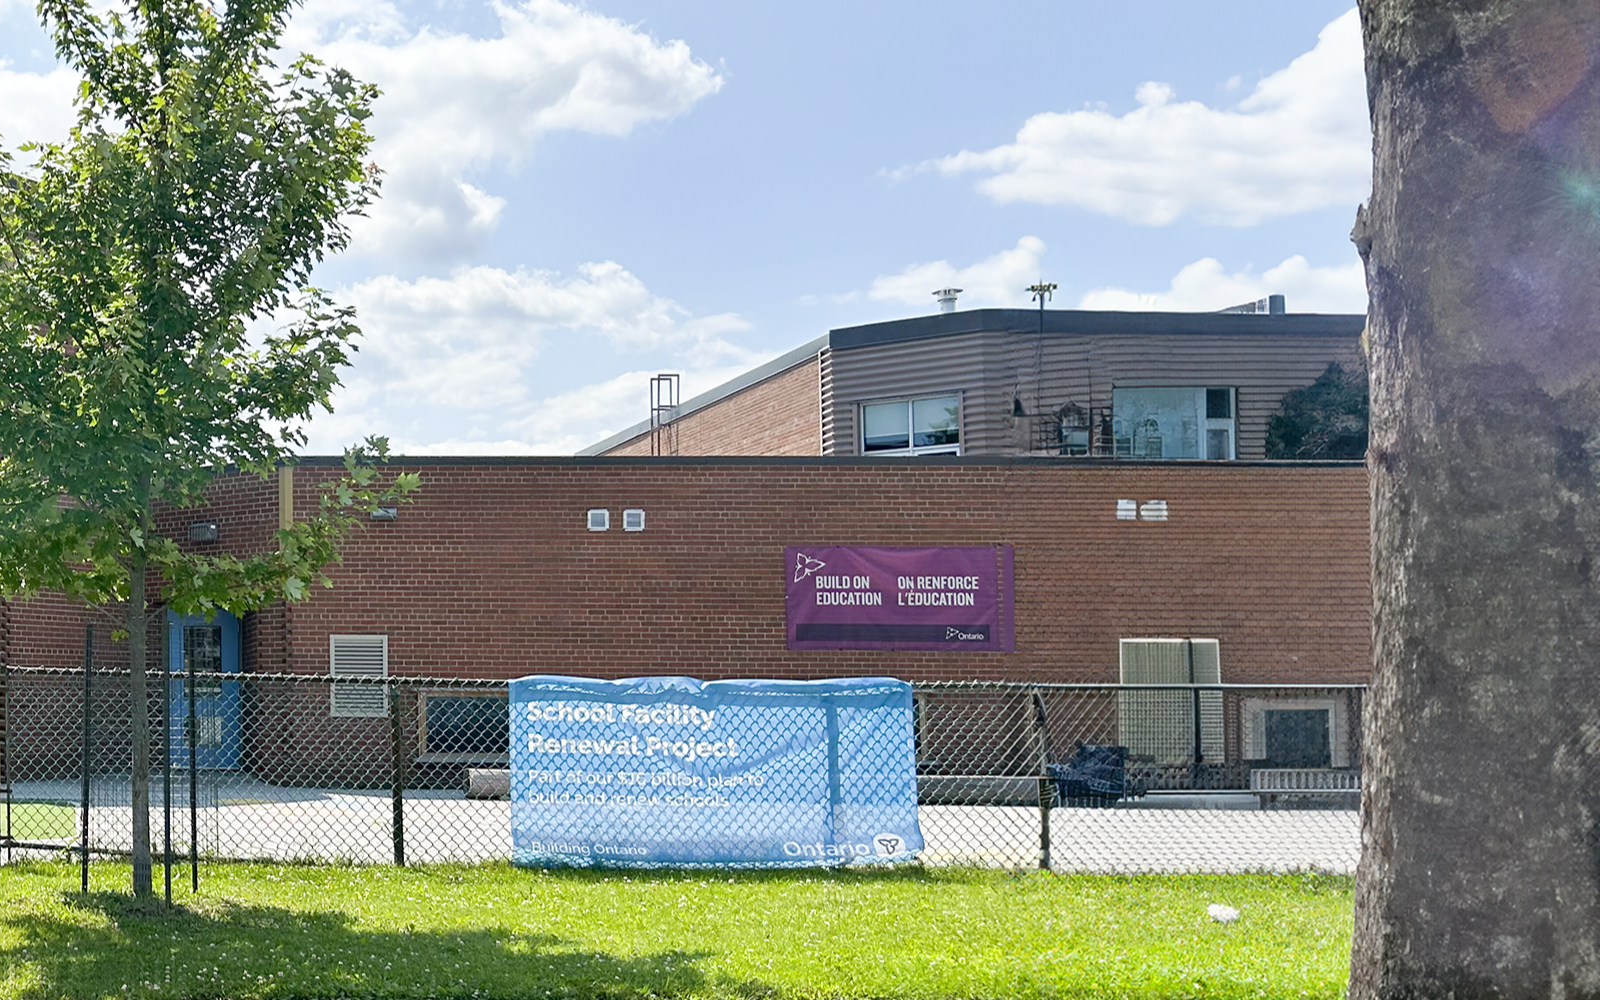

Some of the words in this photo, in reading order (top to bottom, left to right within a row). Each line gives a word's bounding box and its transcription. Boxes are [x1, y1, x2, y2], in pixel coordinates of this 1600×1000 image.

[815, 575, 851, 589] BUILD
[853, 575, 870, 589] ON
[897, 575, 915, 590] ON
[917, 575, 979, 590] RENFORCE
[816, 591, 882, 606] EDUCATION
[897, 589, 975, 606] L'ÉDUCATION
[957, 631, 985, 640] Ontario
[527, 701, 616, 723] School
[621, 703, 715, 731] Facility
[527, 732, 640, 755] Renewal
[646, 735, 740, 762] Project
[528, 769, 562, 784] Part
[565, 769, 583, 784] of
[586, 772, 614, 785] our
[651, 771, 703, 787] billion
[707, 773, 744, 790] plan
[747, 773, 764, 787] to
[528, 789, 570, 804] build
[574, 791, 606, 805] and
[611, 793, 660, 807] renew
[665, 793, 730, 807] schools
[532, 841, 591, 857] Building
[593, 843, 647, 856] Ontario
[783, 839, 870, 857] Ontario
